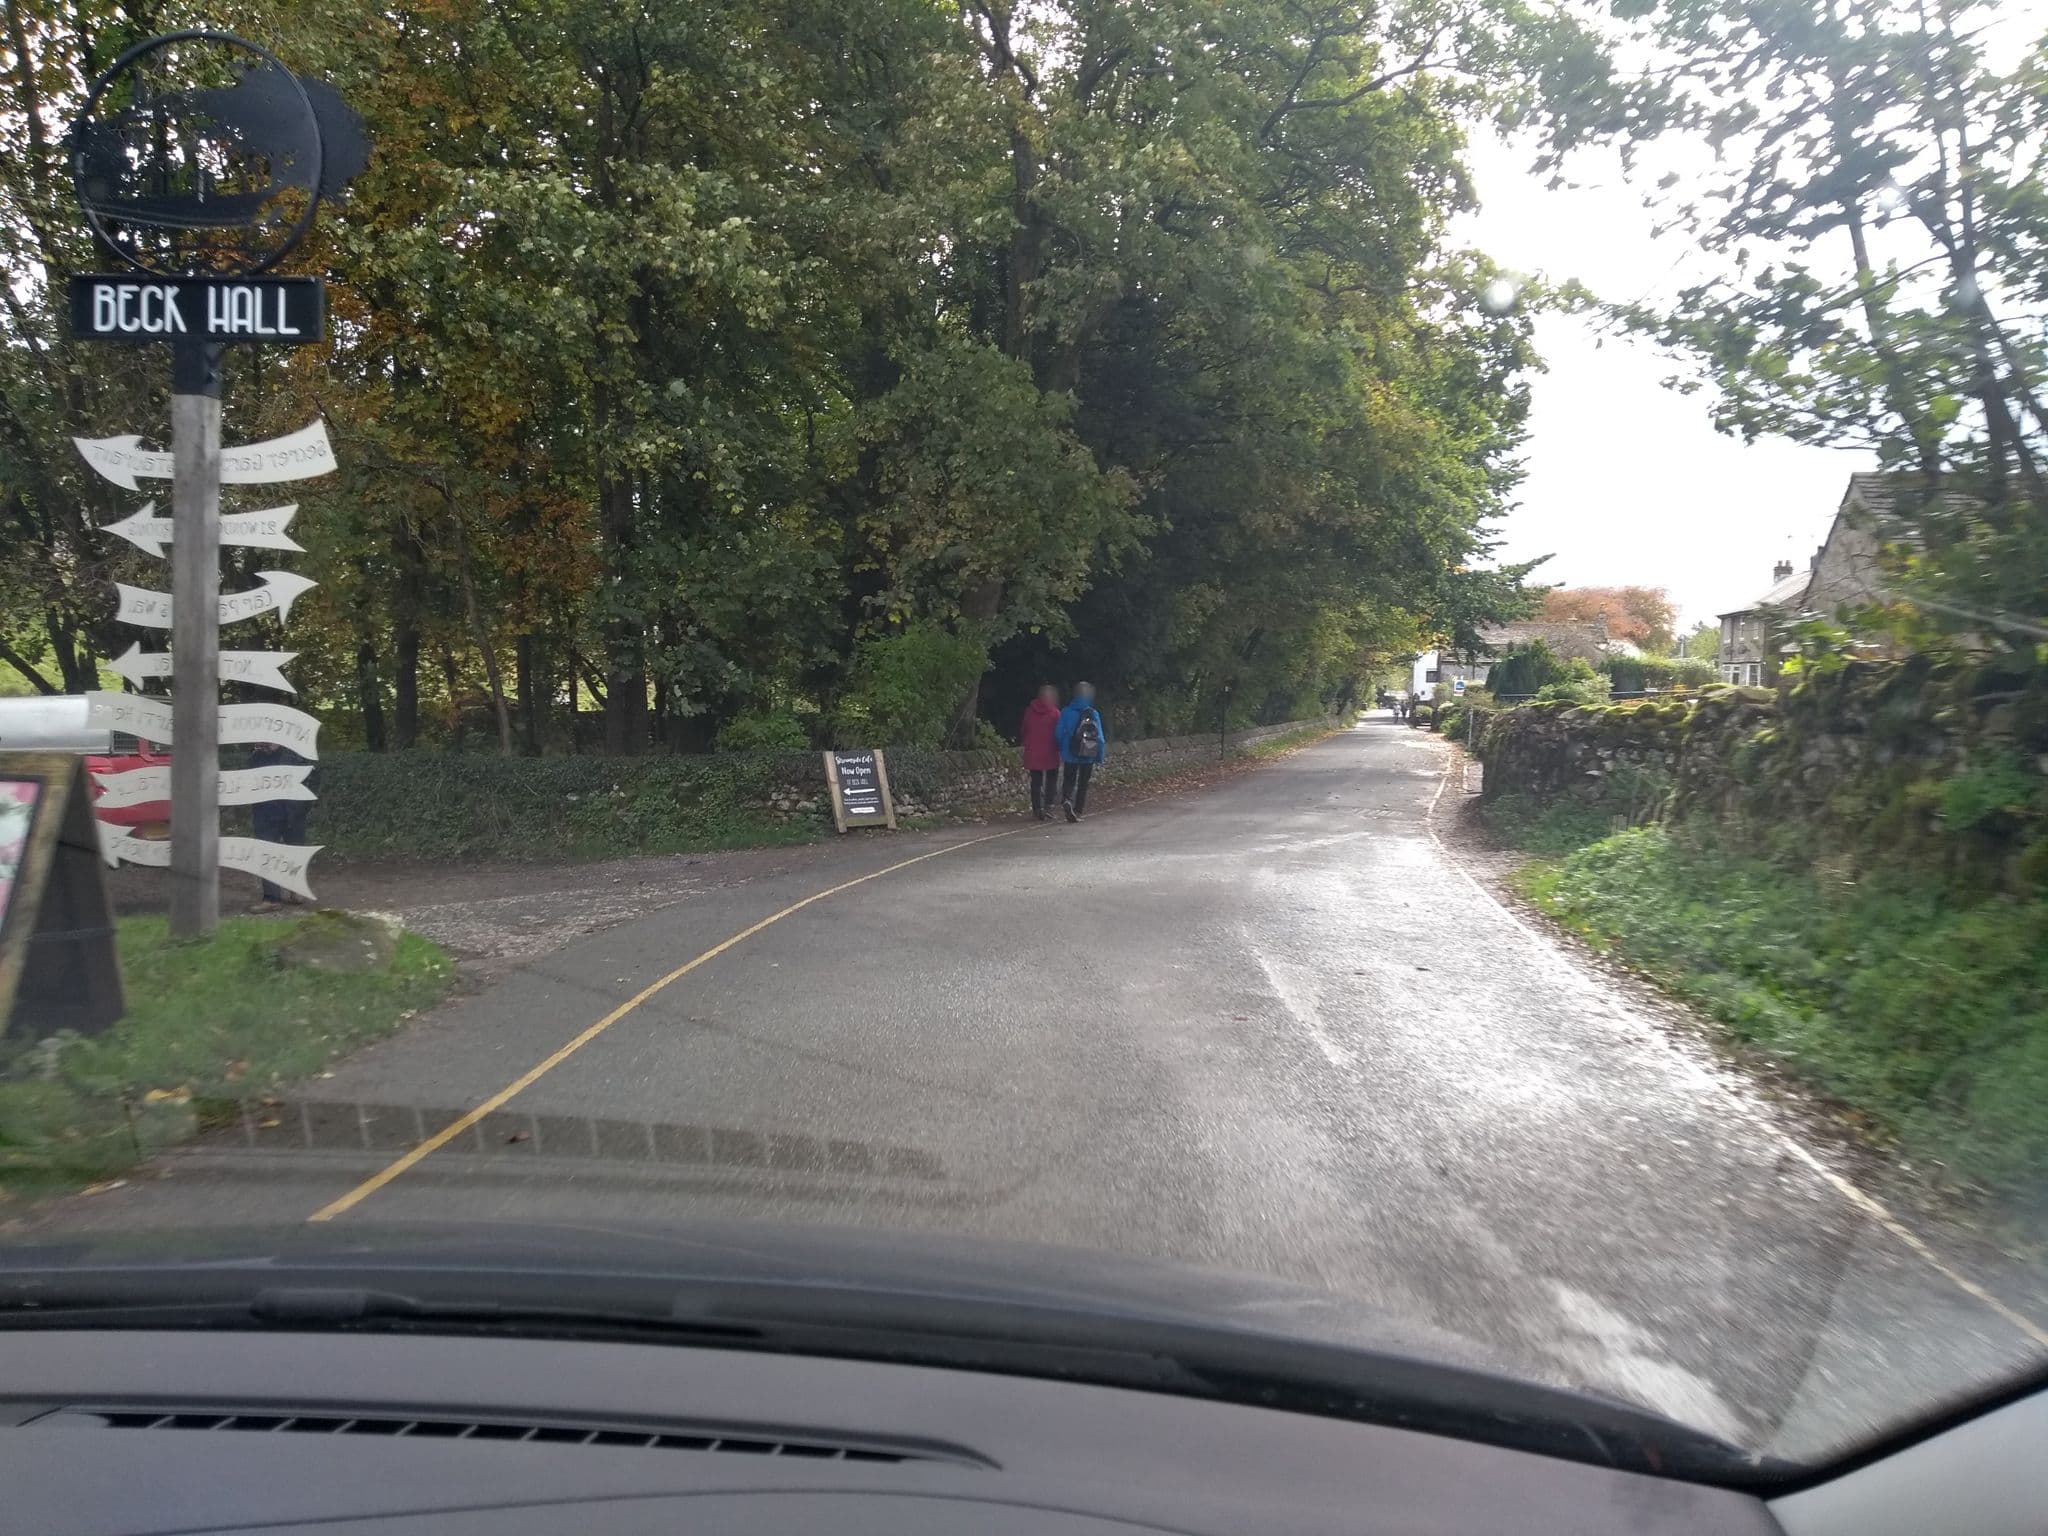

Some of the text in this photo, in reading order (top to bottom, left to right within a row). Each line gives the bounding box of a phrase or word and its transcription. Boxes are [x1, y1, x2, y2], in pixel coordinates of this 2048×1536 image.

[92, 284, 301, 335] BECK HALL
[855, 766, 872, 777] Open
